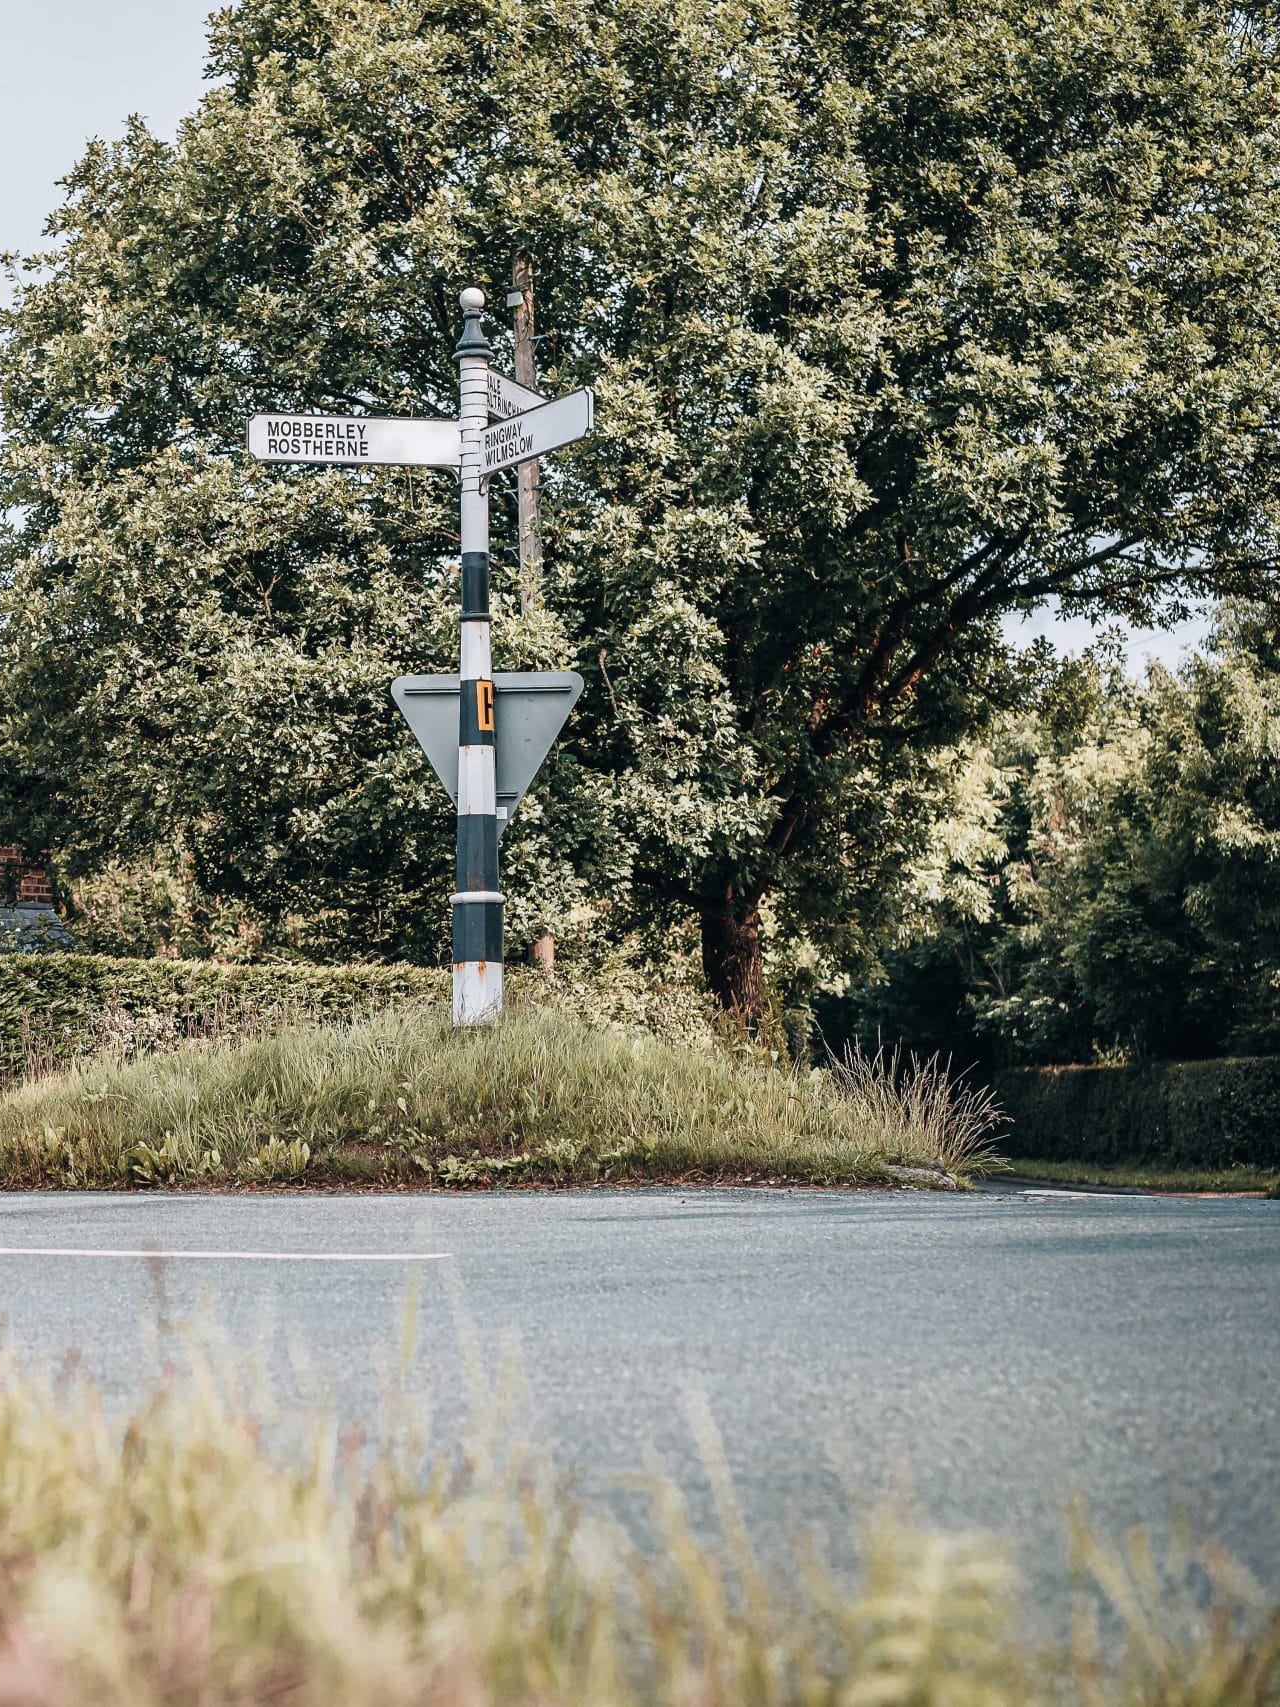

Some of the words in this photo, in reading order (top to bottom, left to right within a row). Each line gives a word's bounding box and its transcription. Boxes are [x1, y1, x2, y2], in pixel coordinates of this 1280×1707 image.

[267, 421, 366, 439] MOBBERLEY
[485, 421, 523, 449] RINGWAY
[268, 439, 369, 456] ROSTHERNE
[485, 434, 534, 466] WILMSLOW
